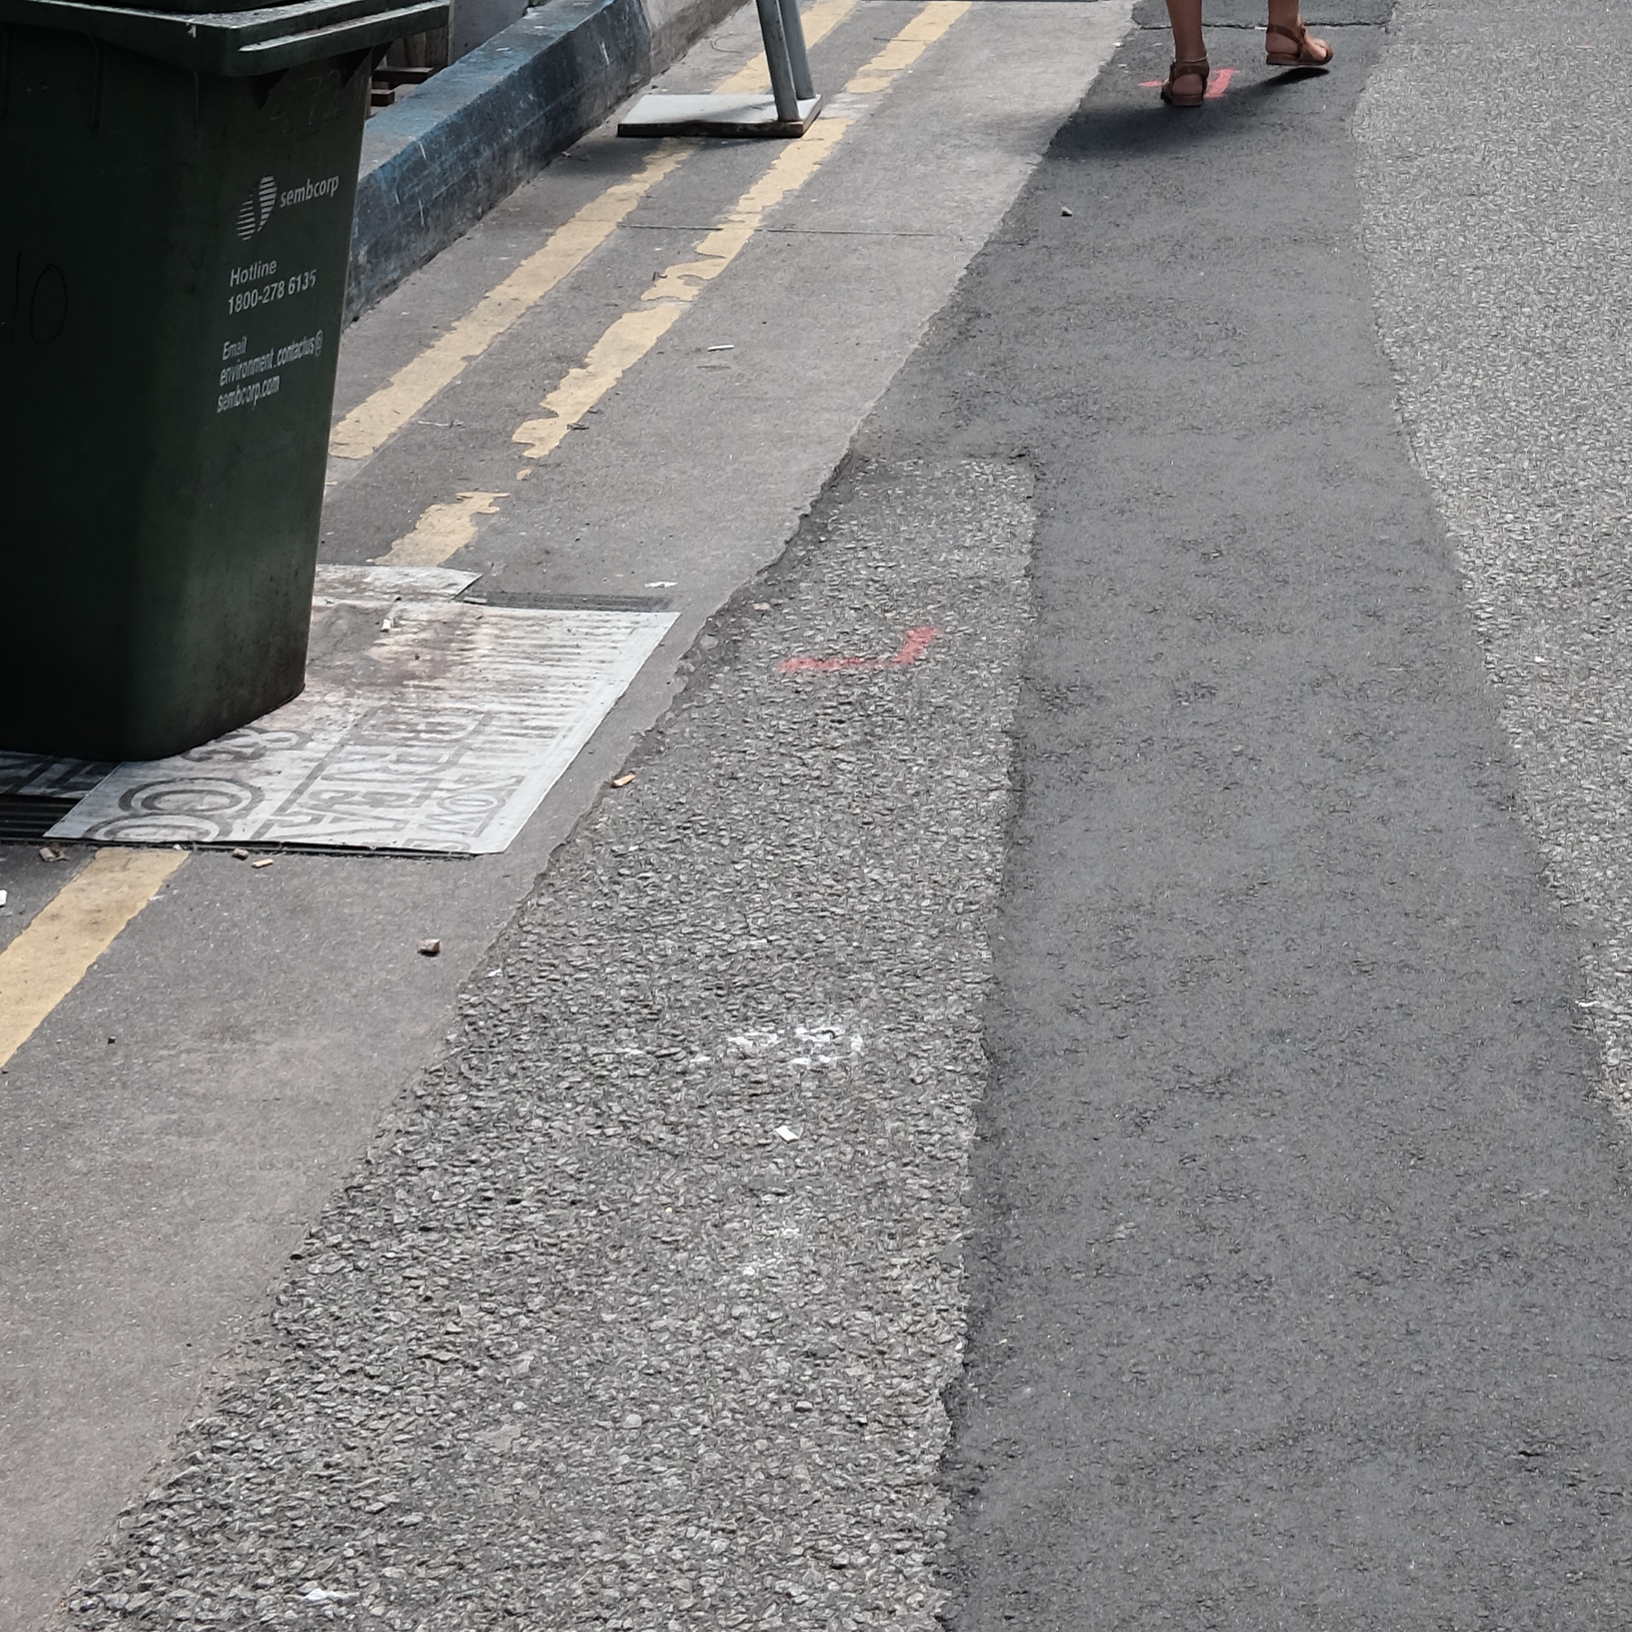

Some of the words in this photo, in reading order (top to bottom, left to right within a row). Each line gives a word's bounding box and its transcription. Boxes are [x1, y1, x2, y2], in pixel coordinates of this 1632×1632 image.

[279, 174, 340, 209] sembcorp
[229, 258, 278, 288] Hotline
[227, 279, 286, 316] 1800-278
[287, 268, 318, 296] 6135
[221, 335, 248, 361] Email
[216, 373, 281, 414] sembcorp.com
